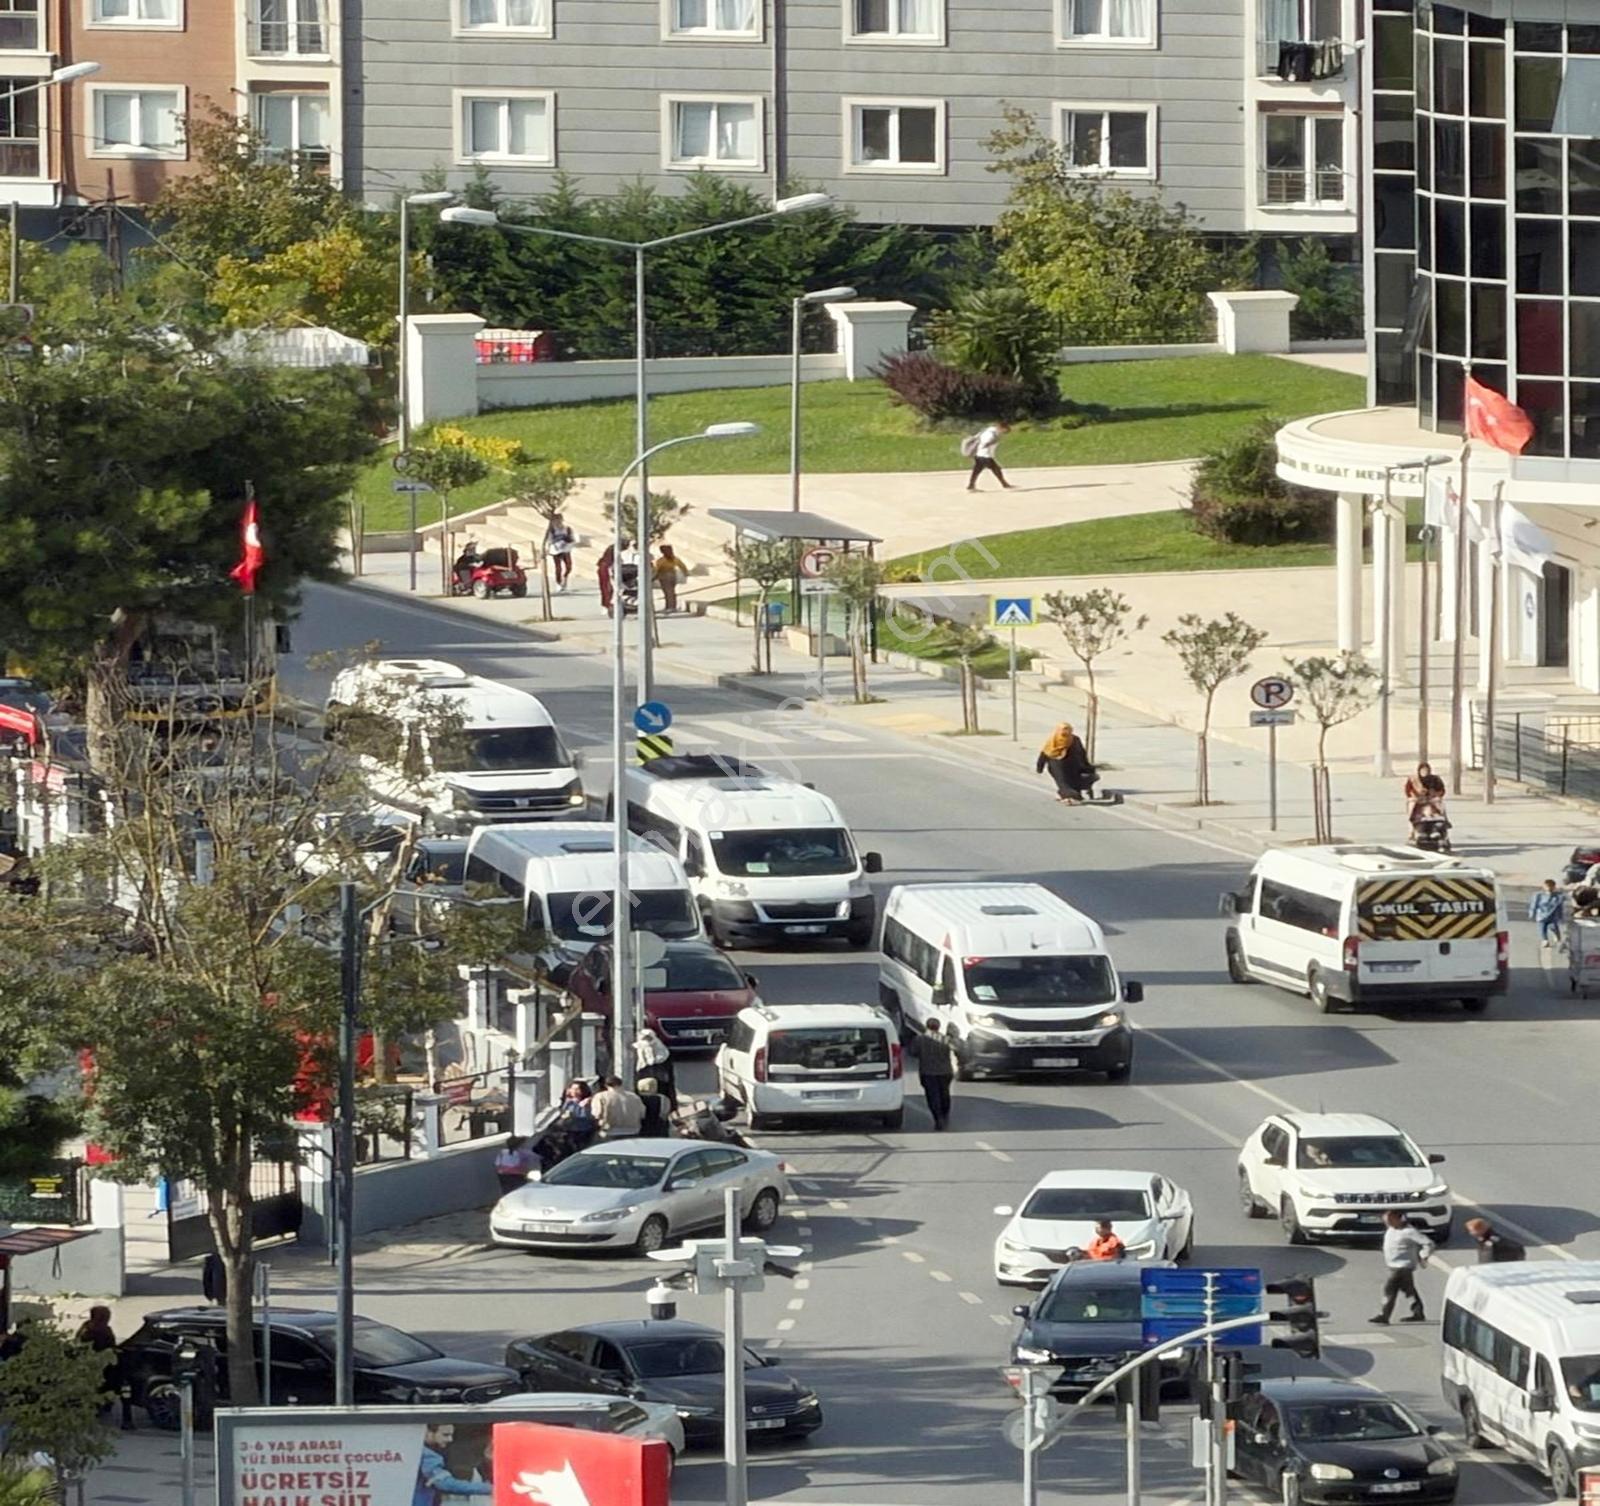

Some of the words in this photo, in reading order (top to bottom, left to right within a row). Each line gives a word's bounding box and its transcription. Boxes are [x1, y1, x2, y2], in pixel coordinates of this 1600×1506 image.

[1372, 903, 1419, 915] OKUL
[240, 1440, 263, 1451] 3-6
[268, 1440, 295, 1452] YAŞ
[299, 1440, 342, 1450] ARASI
[240, 1453, 266, 1465] YÜZ
[271, 1453, 339, 1465] BİNLERCE
[344, 1450, 402, 1466] ÇOCUĞA
[241, 1467, 370, 1490] ÜCRETSİZ
